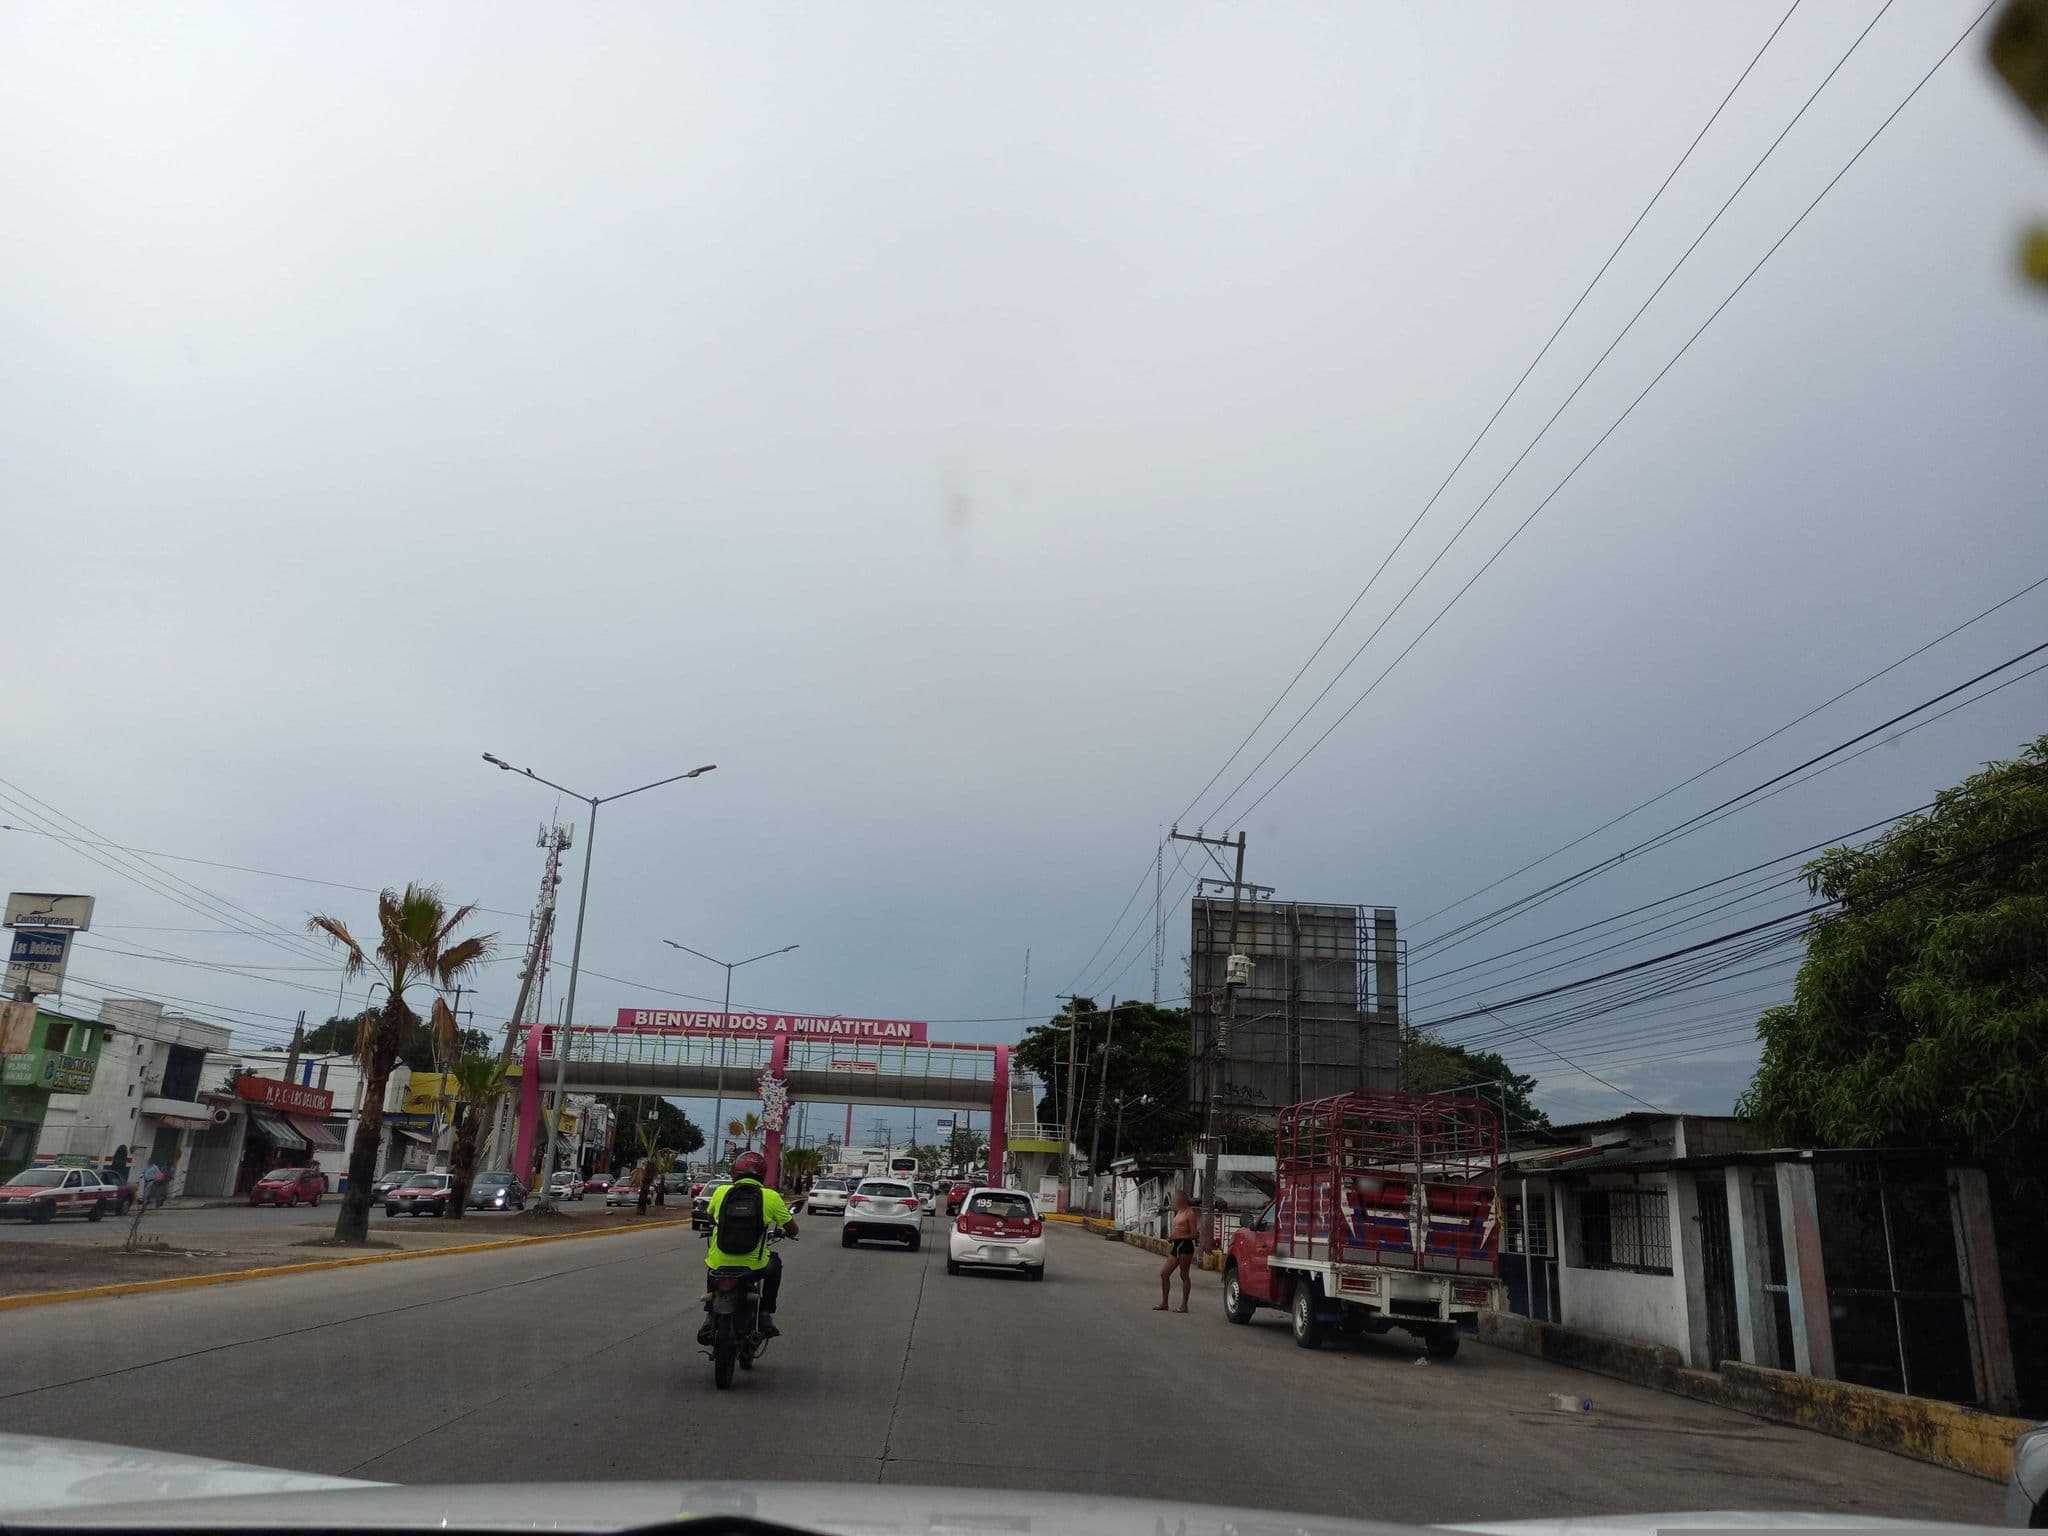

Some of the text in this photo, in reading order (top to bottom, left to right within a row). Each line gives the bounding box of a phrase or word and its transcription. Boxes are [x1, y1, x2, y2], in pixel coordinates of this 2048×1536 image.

[16, 914, 74, 926] Construrama
[635, 1011, 911, 1038] BIENVENIDOS A MINATITLAN
[976, 1198, 993, 1208] 195
